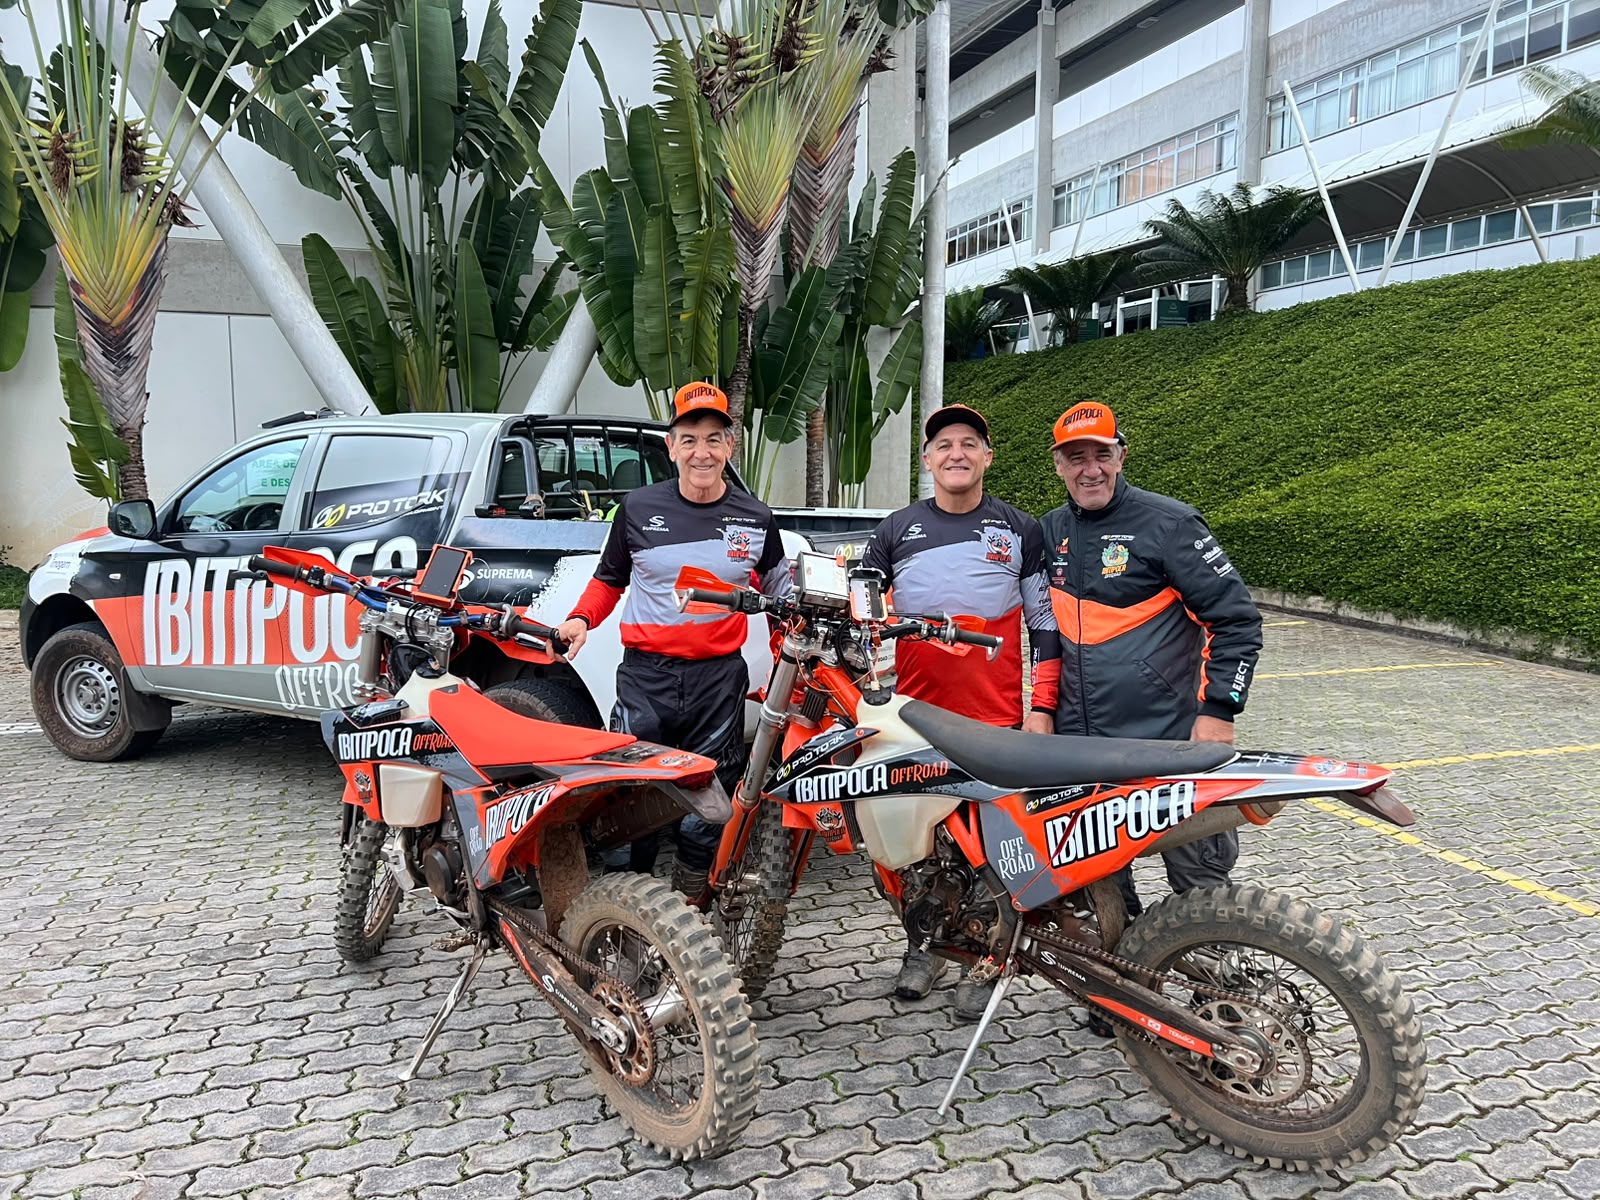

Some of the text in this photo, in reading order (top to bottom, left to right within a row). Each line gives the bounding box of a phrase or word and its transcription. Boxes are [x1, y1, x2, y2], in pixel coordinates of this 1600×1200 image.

[345, 500, 391, 519] PRO
[393, 487, 452, 512] TORK
[476, 568, 533, 579] SUPREMA
[143, 536, 418, 665] IBITIPOC
[274, 661, 361, 710] OFFRO
[1232, 660, 1250, 692] EJECT
[338, 727, 413, 760] IBITIPOCA
[792, 751, 814, 770] PRO
[813, 733, 845, 755] TORK
[795, 761, 949, 803] IBITIPOCA OFFROAD
[1040, 793, 1058, 805] PRO
[1058, 784, 1084, 799] TORK
[1045, 780, 1195, 868] IBITIPOCA
[1000, 836, 1024, 861] OFF
[998, 852, 1036, 881] ROAD
